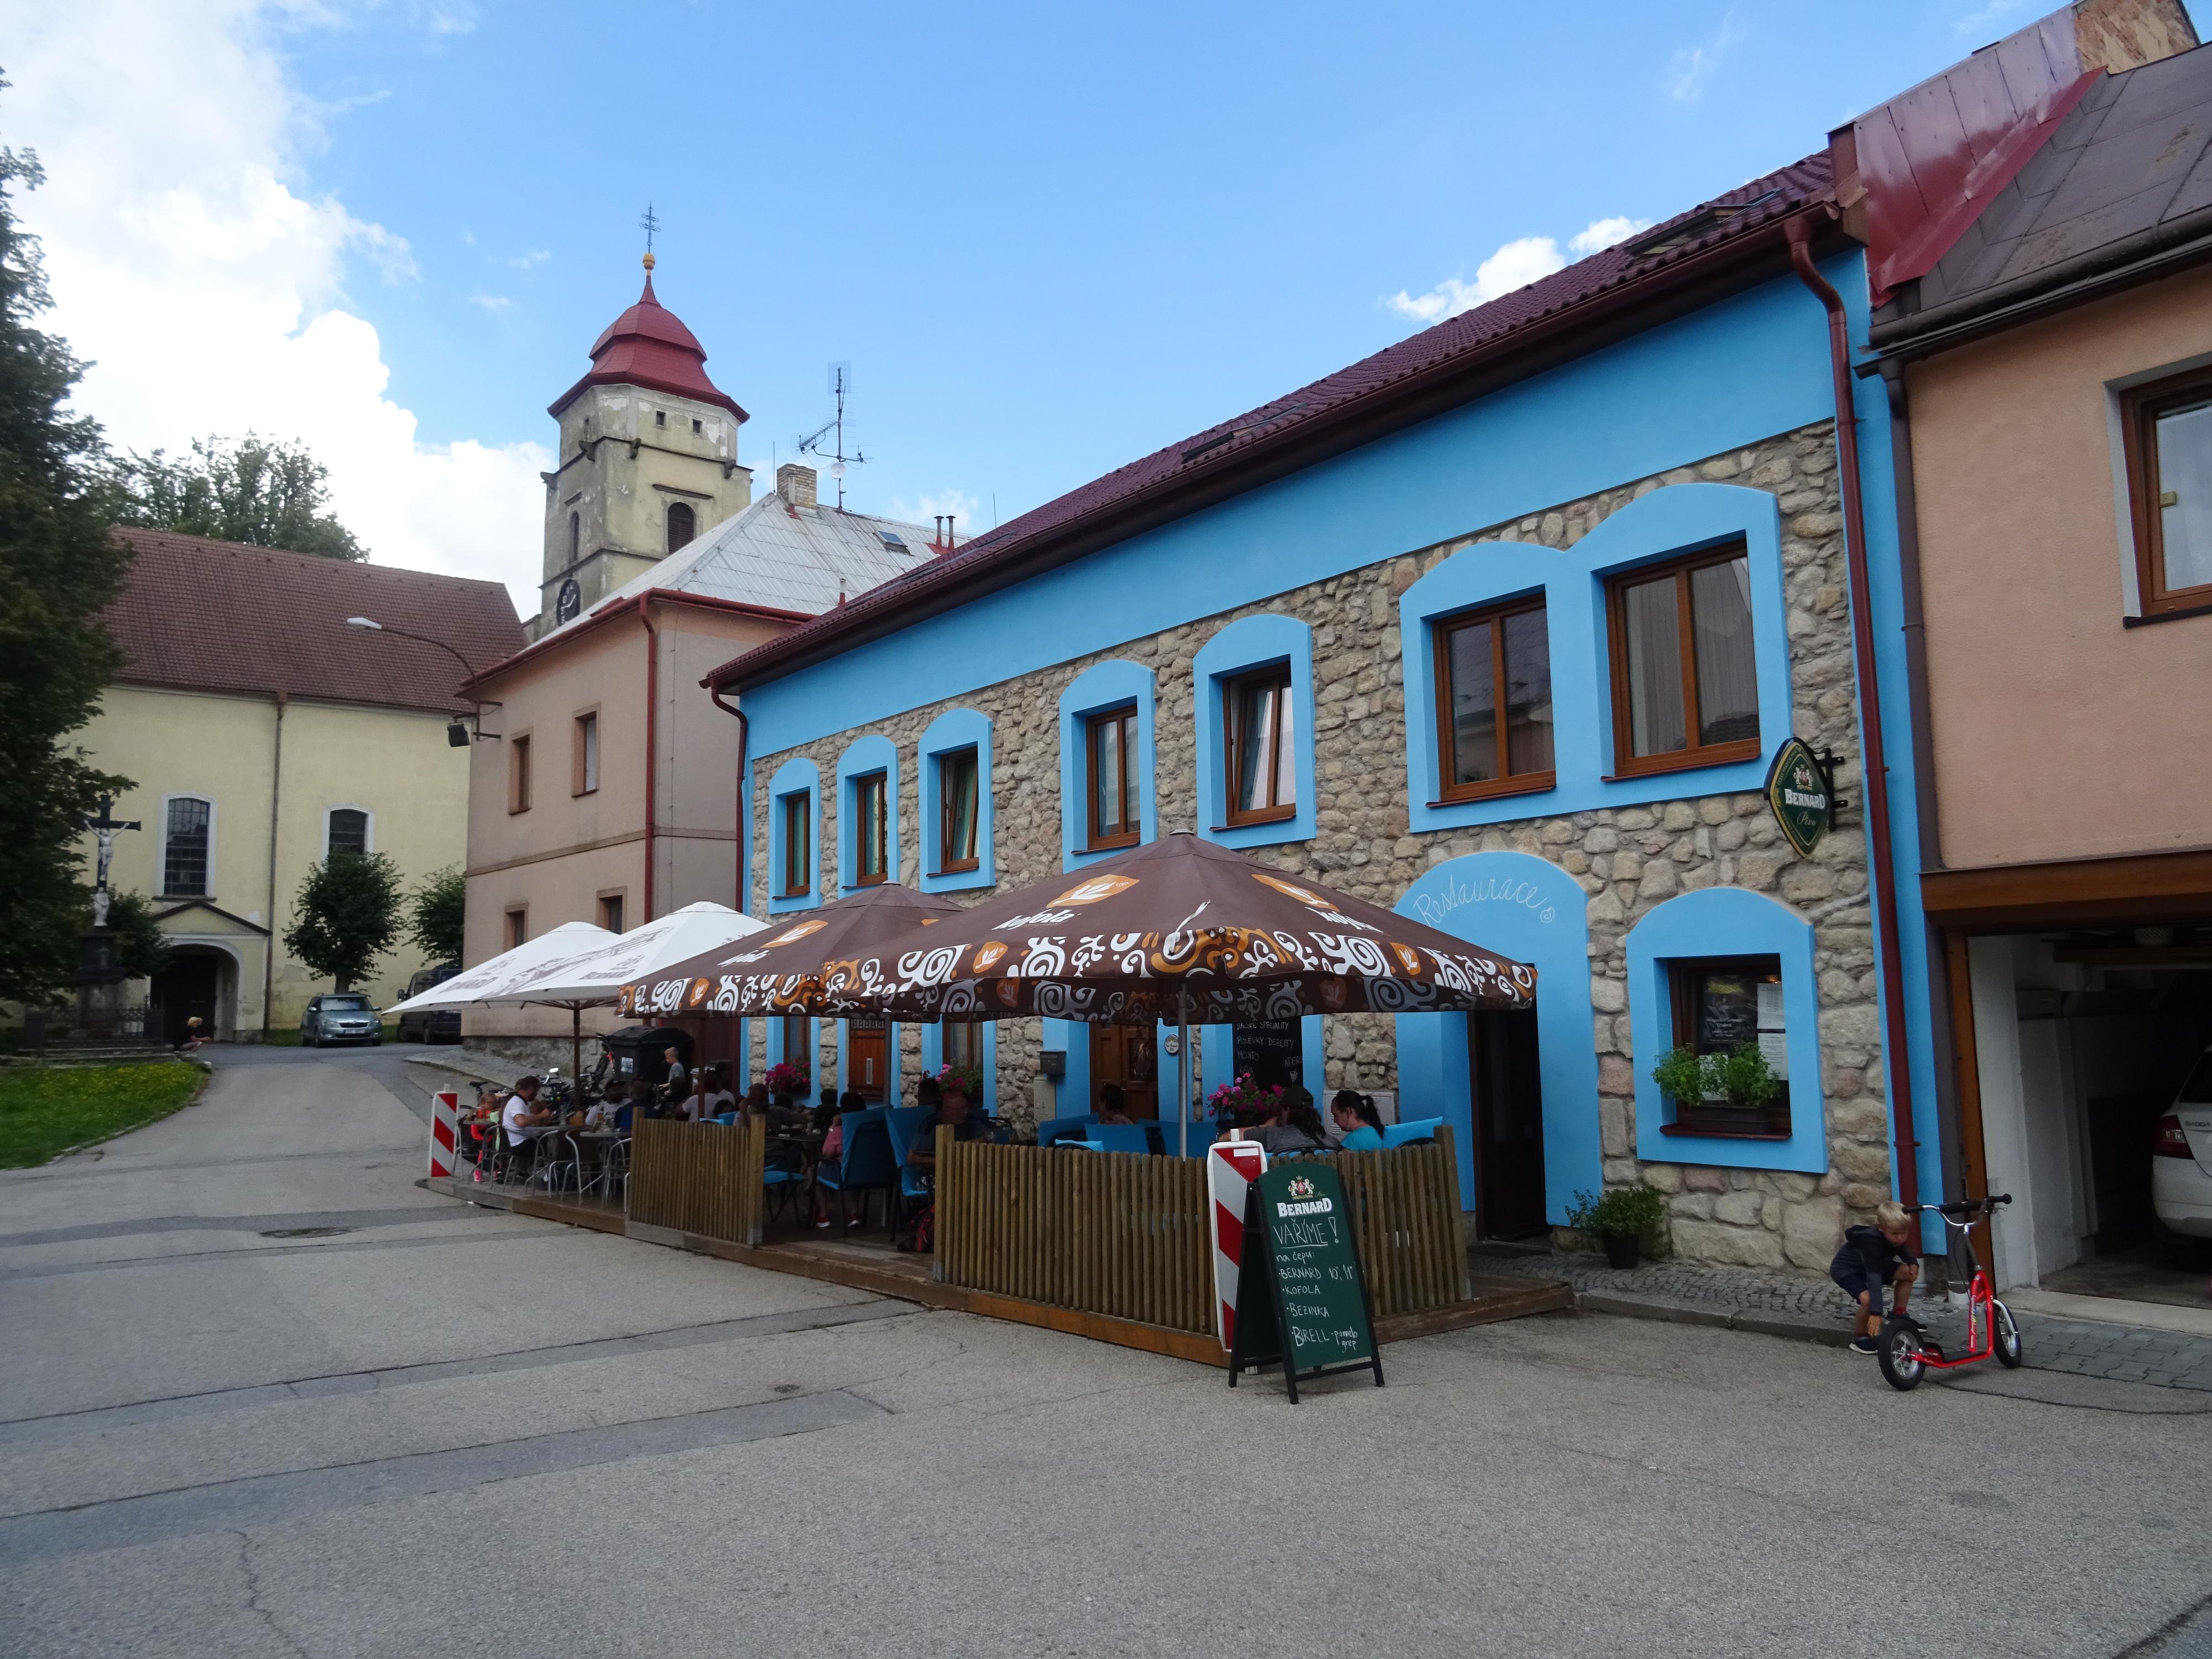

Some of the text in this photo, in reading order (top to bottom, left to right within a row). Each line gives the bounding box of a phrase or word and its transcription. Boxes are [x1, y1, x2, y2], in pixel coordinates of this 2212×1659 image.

[1784, 789, 1825, 810] BERNARD
[1413, 874, 1547, 927] Restaurace
[1276, 1198, 1332, 1217] BERNARD
[1276, 1254, 1290, 1262] na
[1285, 1284, 1321, 1295] KOFOLA
[1292, 1326, 1329, 1347] BIRELL
